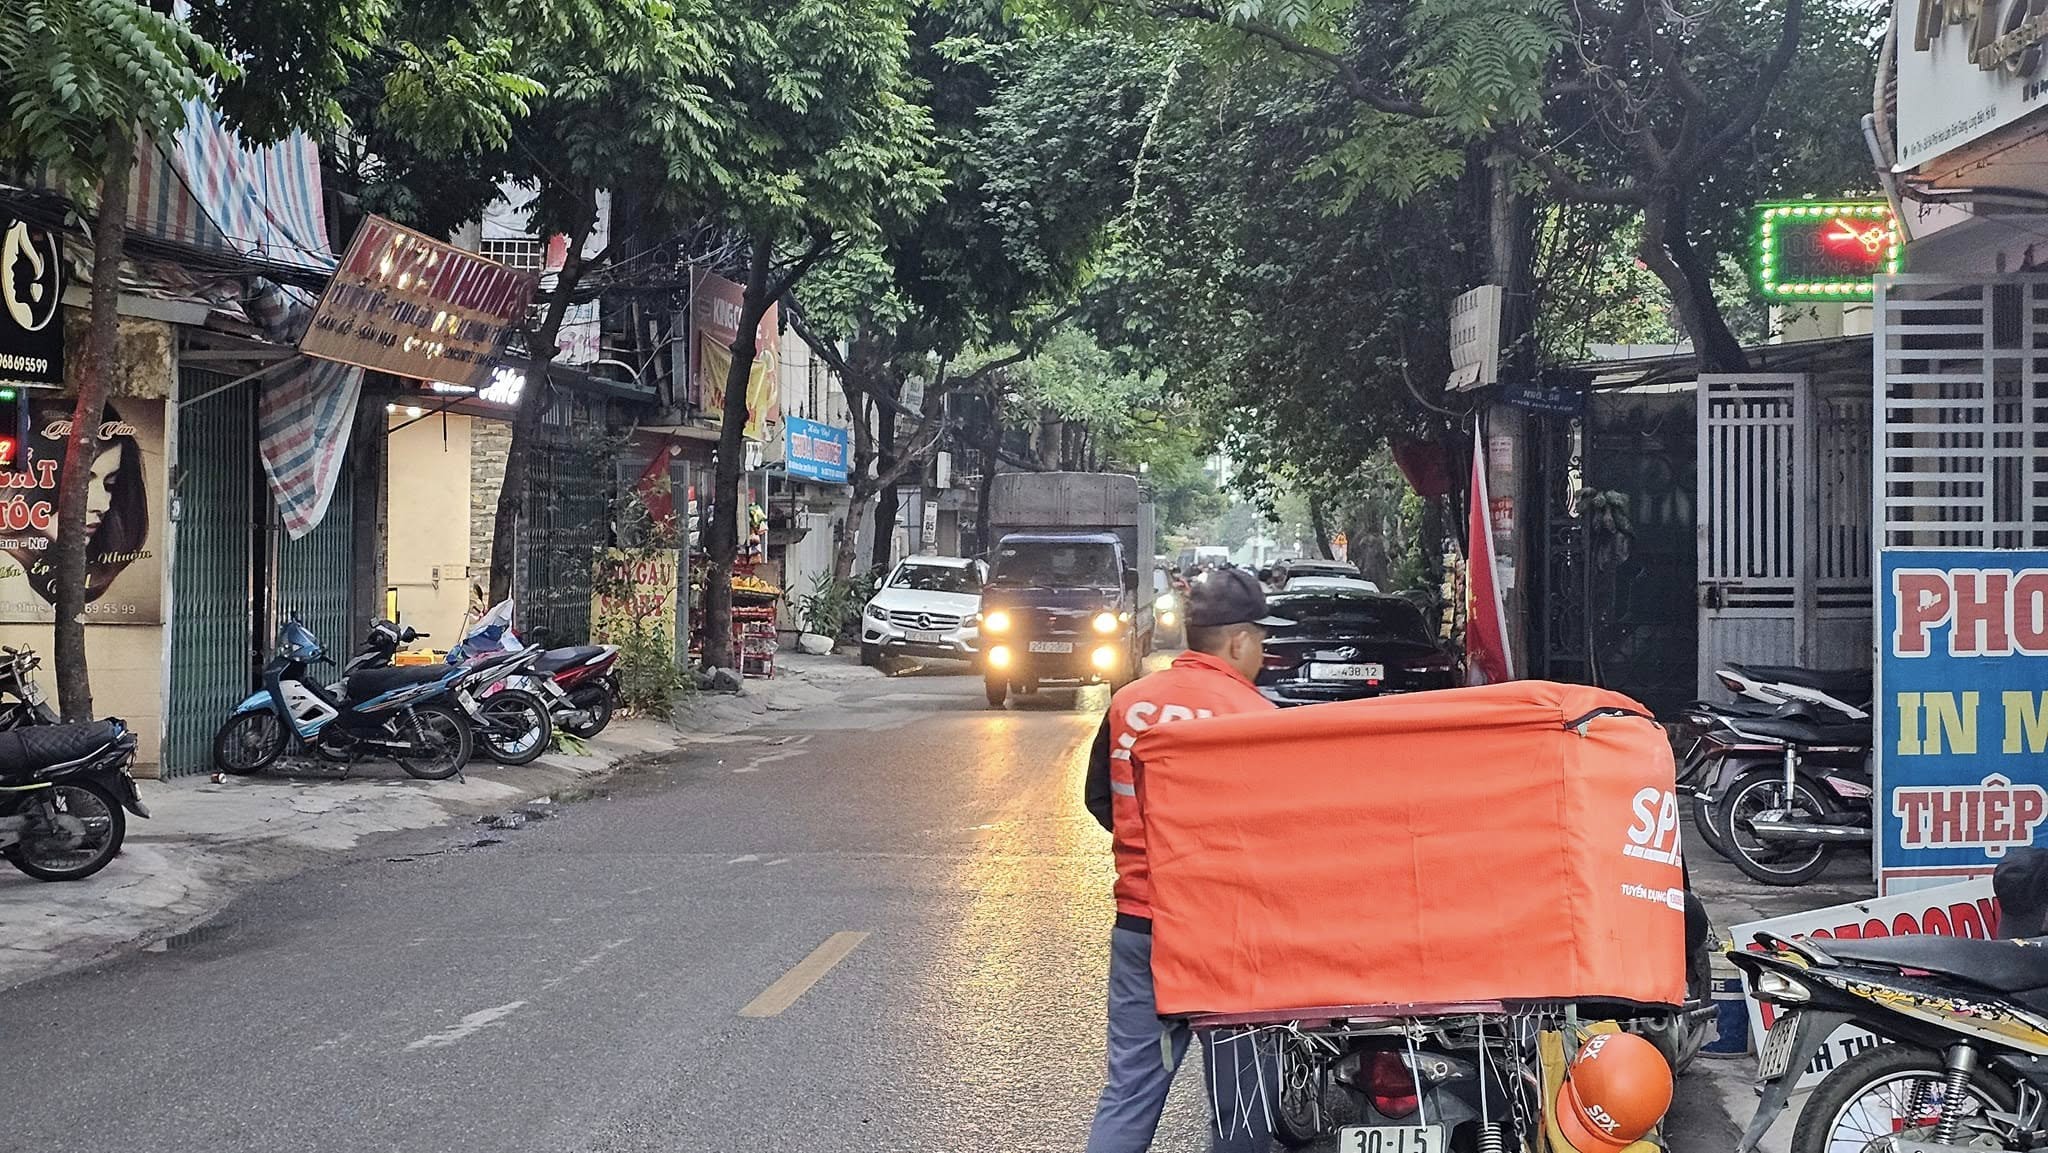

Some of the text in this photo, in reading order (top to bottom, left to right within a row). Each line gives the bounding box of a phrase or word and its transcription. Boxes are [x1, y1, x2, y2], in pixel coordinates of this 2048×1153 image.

[0, 538, 18, 549] am
[1897, 691, 1979, 755] IN
[1895, 775, 2044, 856] THIỆP
[1580, 1034, 1612, 1063] SPX
[1588, 1104, 1621, 1135] SPX
